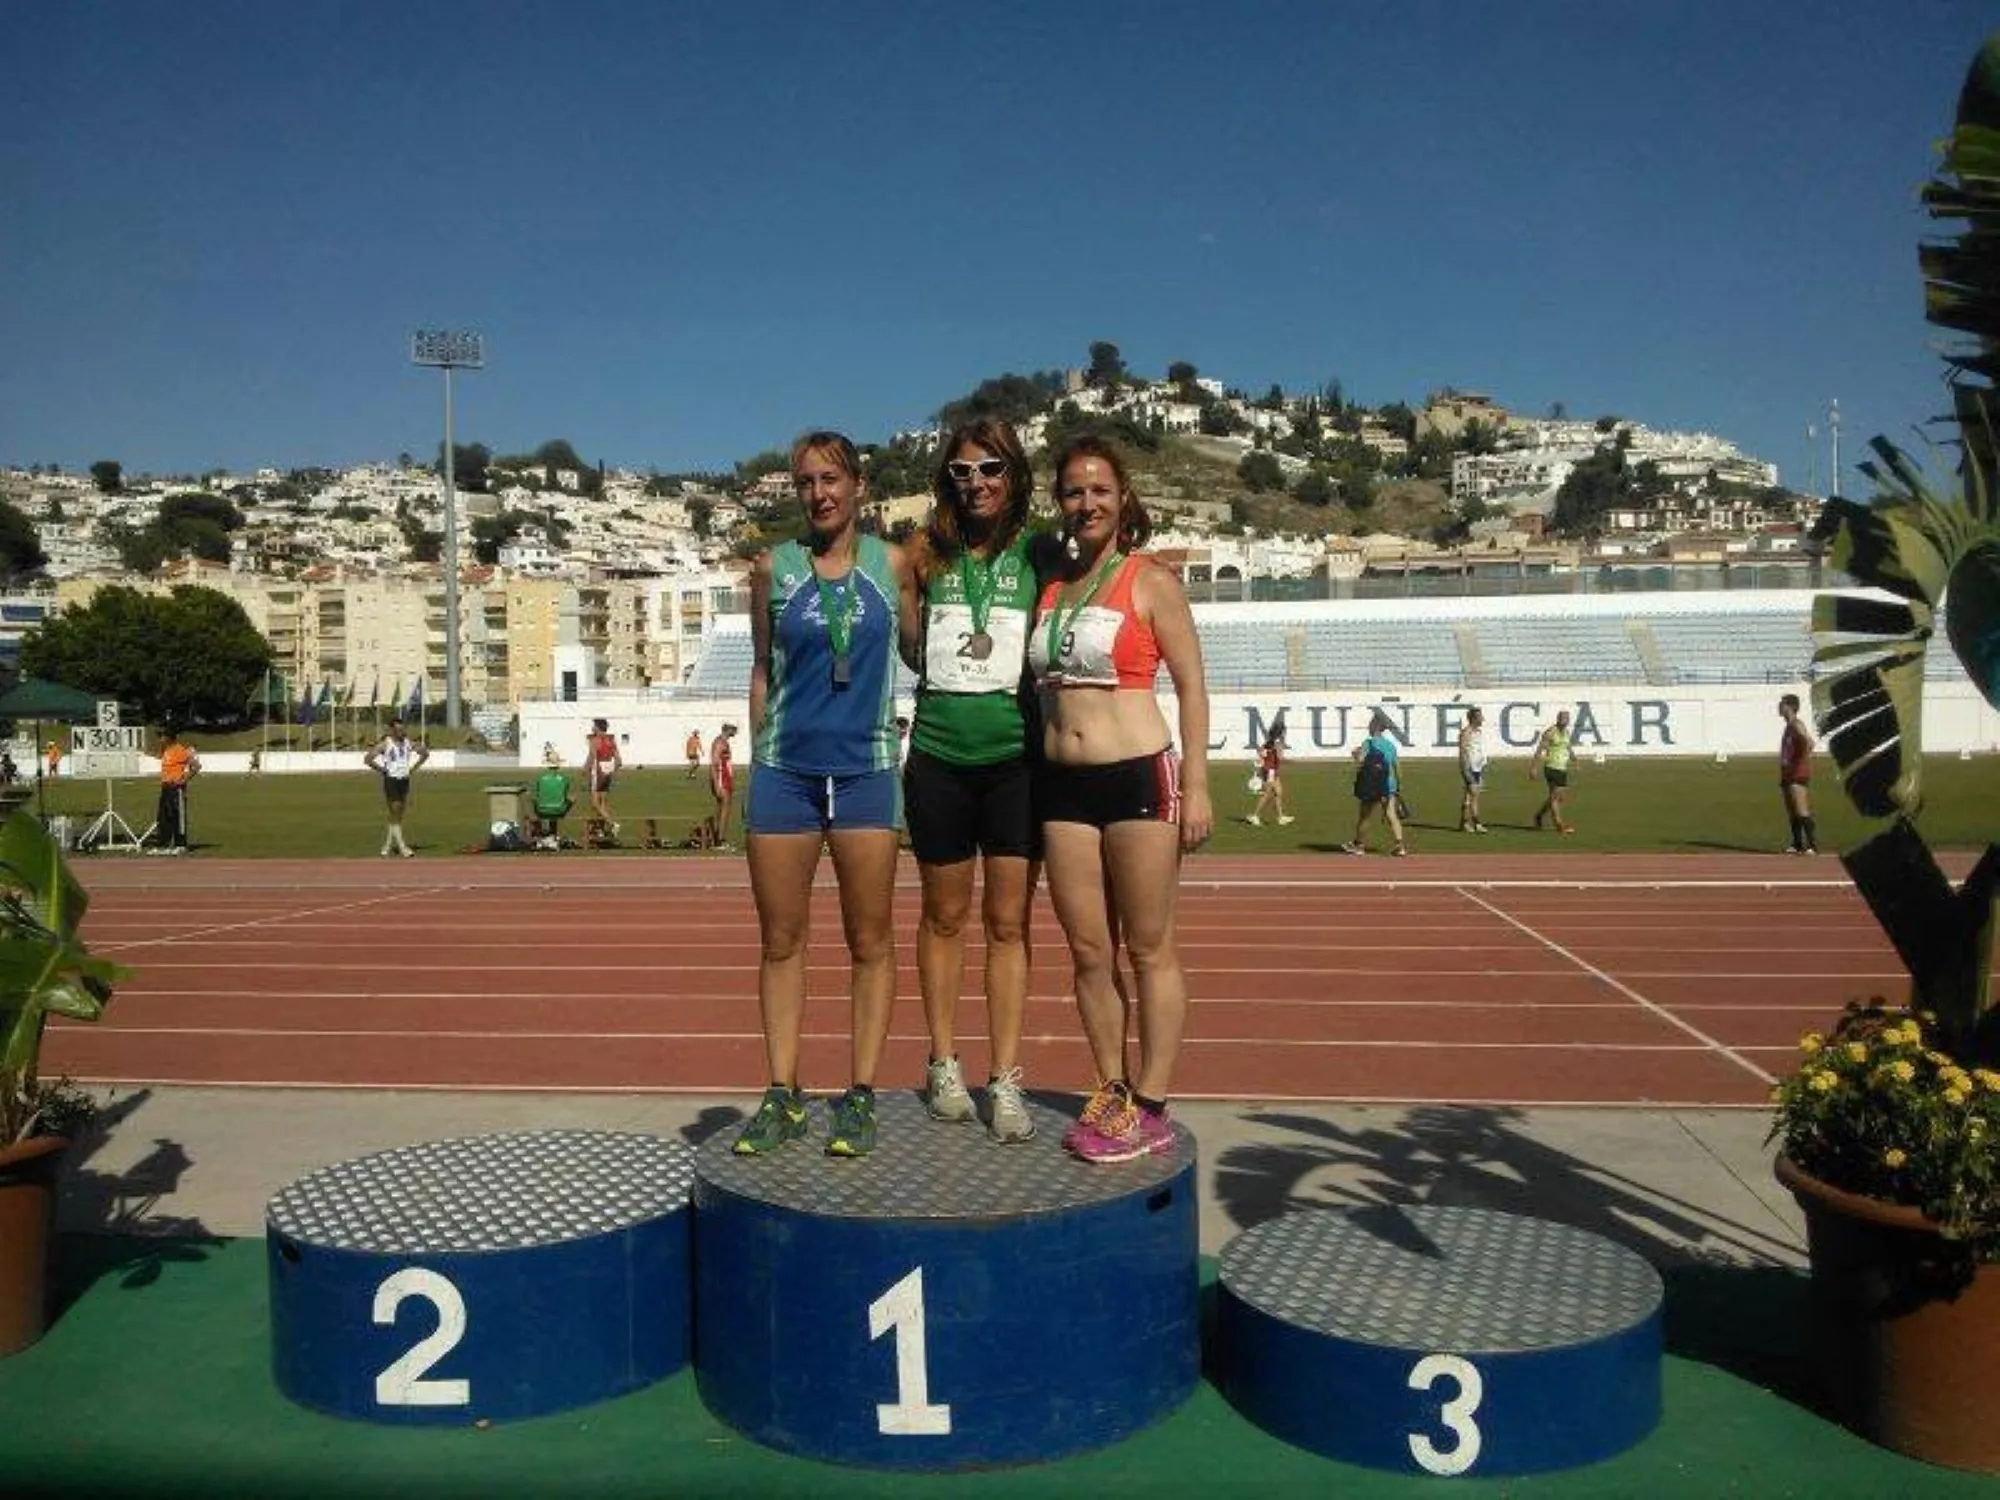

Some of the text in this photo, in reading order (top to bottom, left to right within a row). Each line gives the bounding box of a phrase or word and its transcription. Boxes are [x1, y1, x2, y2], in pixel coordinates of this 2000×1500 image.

[102, 703, 115, 722] 5
[371, 1267, 470, 1406] 2
[868, 1265, 951, 1436] 1
[1408, 1353, 1483, 1477] 3
